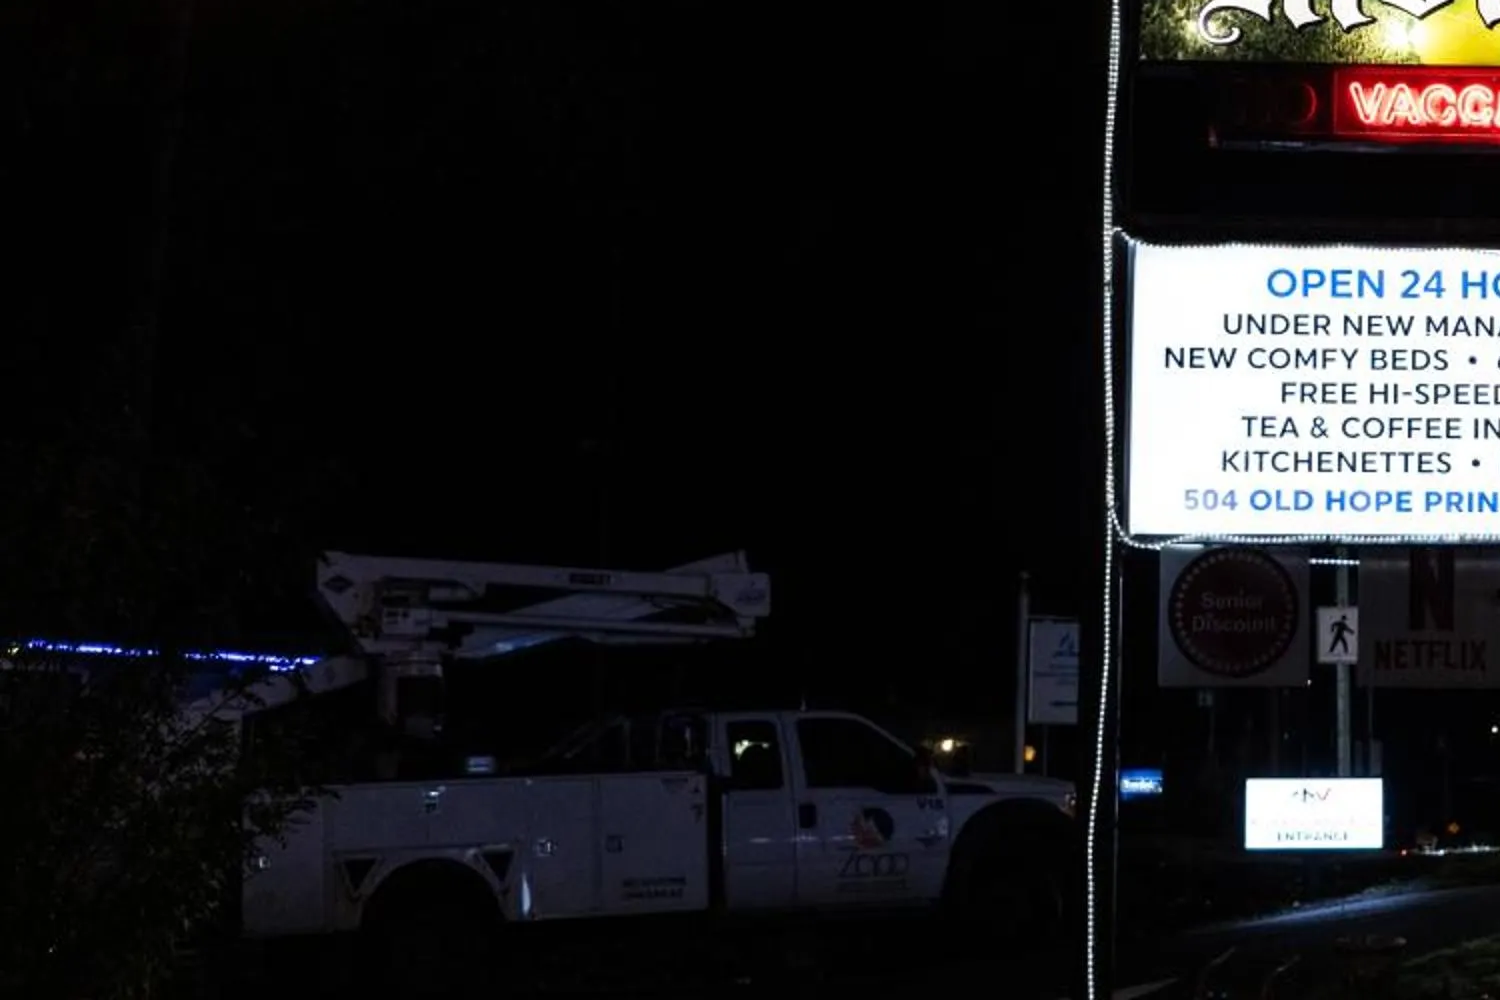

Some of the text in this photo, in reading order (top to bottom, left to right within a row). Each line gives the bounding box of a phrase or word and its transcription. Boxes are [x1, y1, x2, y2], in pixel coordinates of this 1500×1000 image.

[1267, 268, 1384, 299] OPEN
[1401, 270, 1446, 299] 24
[1223, 314, 1330, 336] UNDER
[1344, 315, 1414, 337] NEW
[1165, 347, 1234, 369] NEW
[1248, 348, 1358, 370] COMFY
[1371, 349, 1449, 371] BEDS
[1281, 382, 1357, 405] FREE
[1241, 416, 1299, 438] TEA
[1310, 416, 1329, 439] &
[1342, 417, 1462, 439] COFFEE
[1221, 451, 1452, 474] KITCHENETTES
[1184, 489, 1238, 511] 504
[1249, 489, 1314, 512] OLD
[1326, 490, 1412, 513] HOPE
[1375, 640, 1486, 671] NETFLIX
